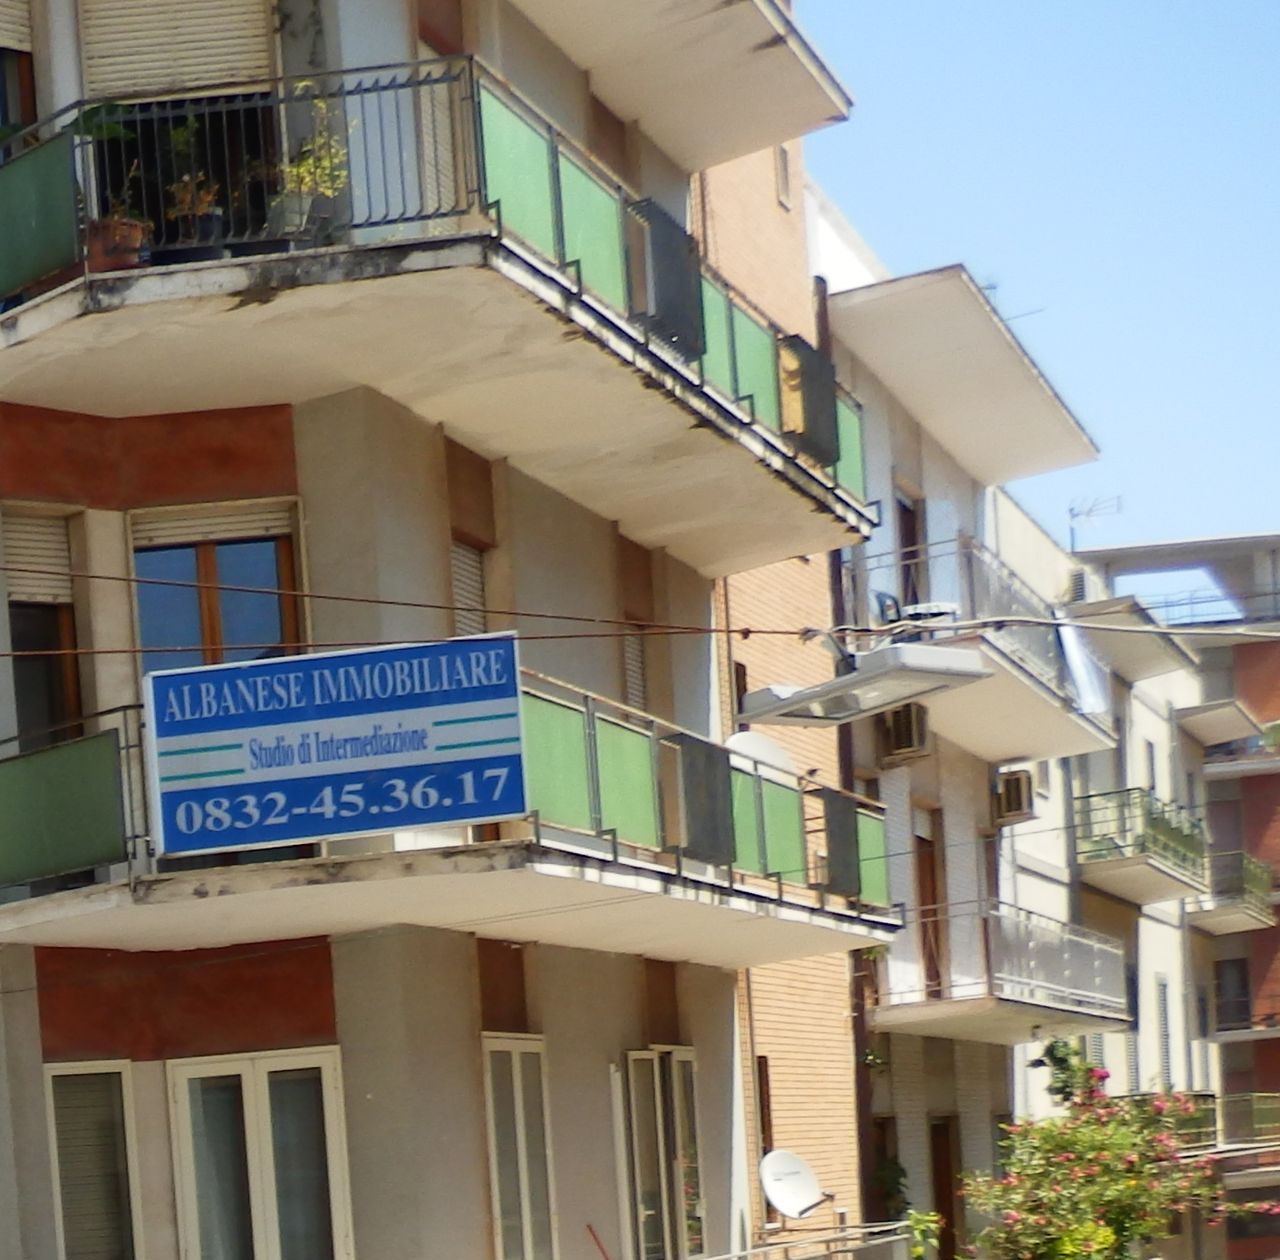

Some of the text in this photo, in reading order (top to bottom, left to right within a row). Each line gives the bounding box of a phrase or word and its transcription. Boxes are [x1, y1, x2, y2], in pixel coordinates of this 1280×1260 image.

[163, 649, 507, 722] ALBANESE IMMOBILIARE
[248, 723, 429, 770] Studio di Intermediazione
[175, 767, 510, 834] 0832-45.36.17
